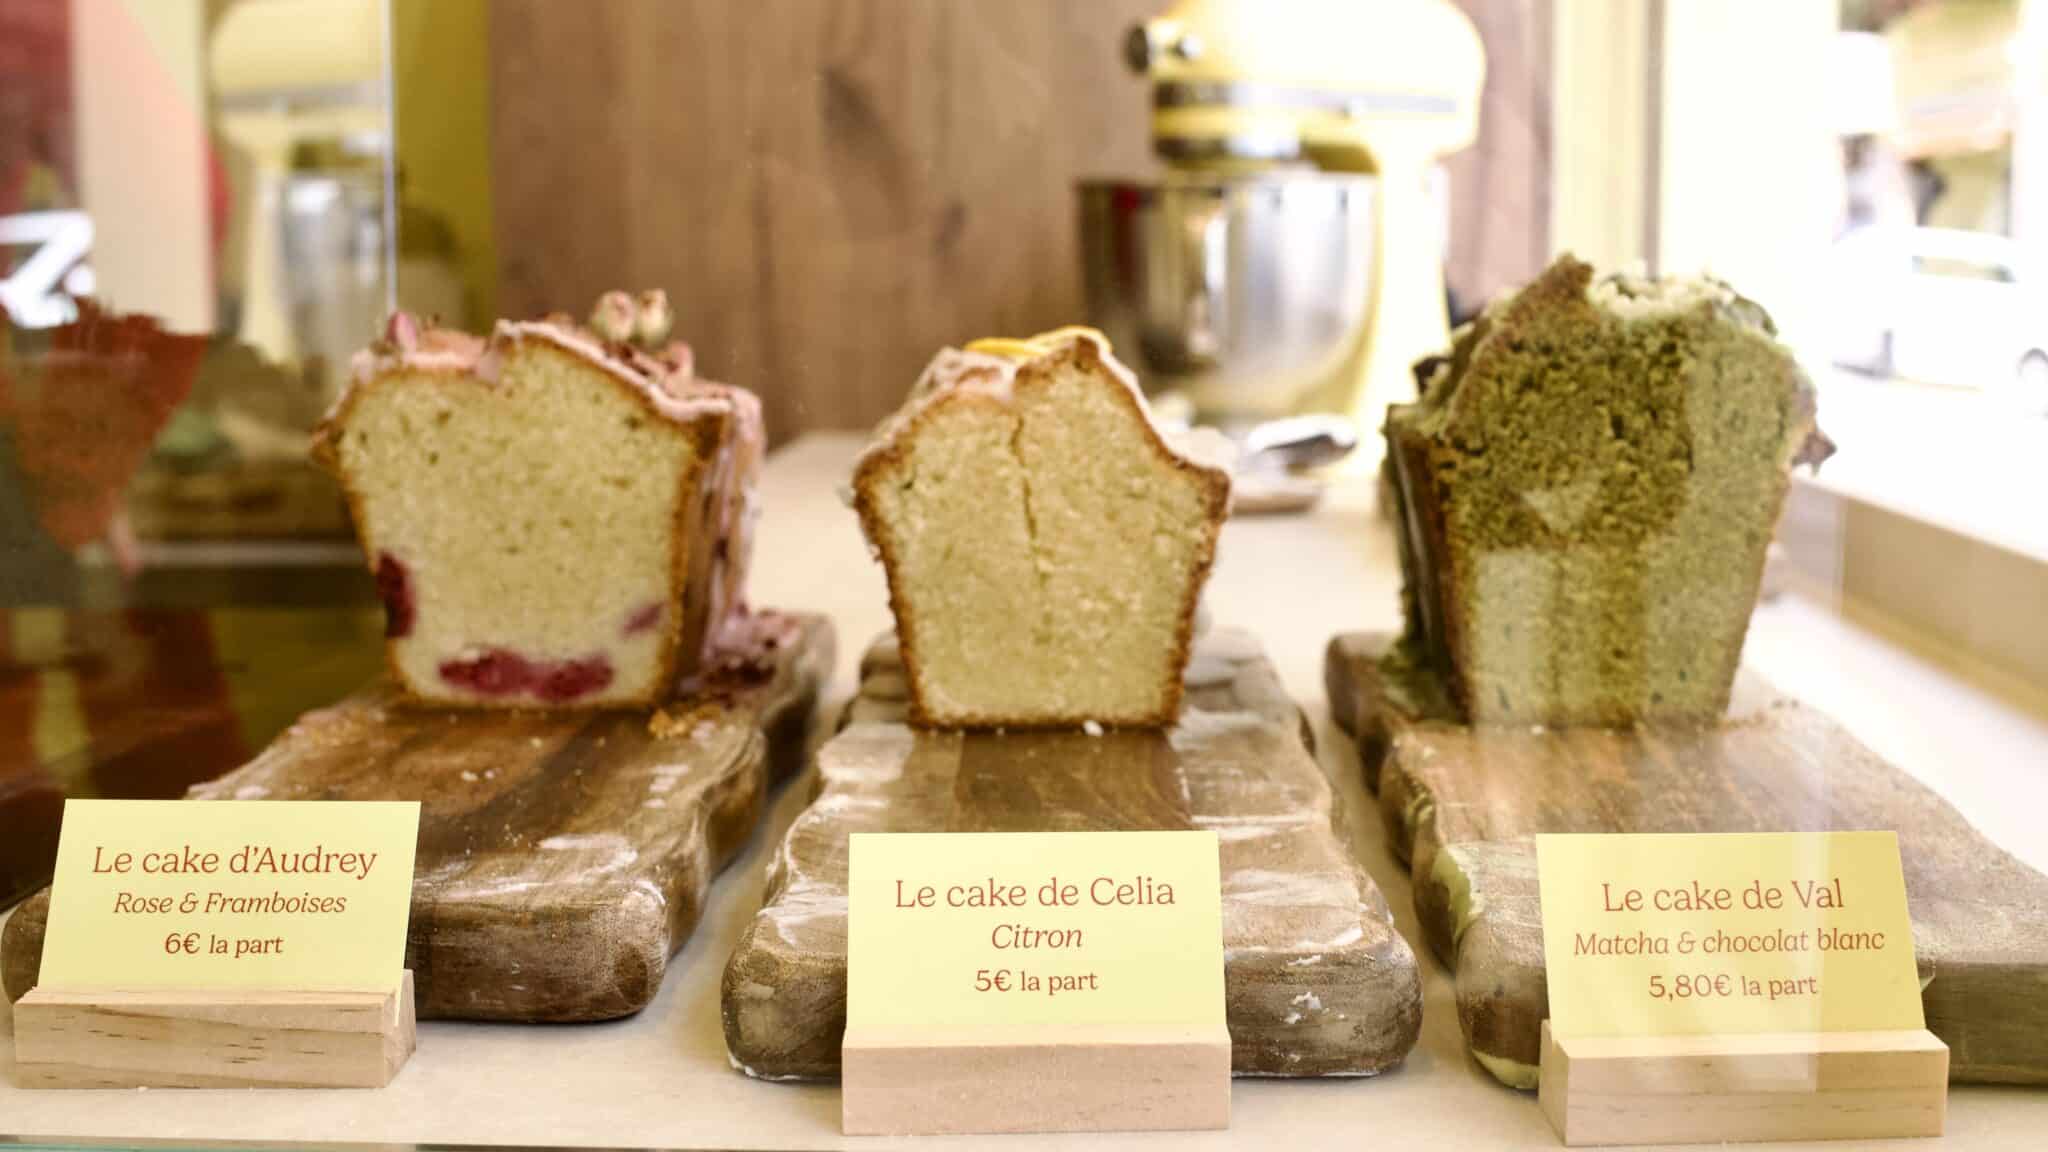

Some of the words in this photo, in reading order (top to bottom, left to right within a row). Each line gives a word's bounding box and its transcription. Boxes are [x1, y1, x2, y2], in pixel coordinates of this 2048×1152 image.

[91, 845, 133, 875] Le
[142, 844, 220, 875] cake
[112, 891, 174, 915] Rose
[178, 891, 200, 915] &
[203, 890, 348, 914] Framboises
[895, 879, 937, 909] Le
[946, 876, 1027, 908] cake
[1037, 876, 1080, 907] de
[1089, 875, 1176, 907] Celia
[1601, 882, 1644, 913] Le
[1653, 879, 1733, 912] cake
[1742, 879, 1784, 910] de
[1790, 877, 1845, 909] Val
[163, 932, 201, 955] 6€
[207, 933, 229, 955] la
[233, 936, 285, 960] part
[991, 923, 1083, 950] Citron
[1573, 930, 1670, 957] Matcha
[1676, 931, 1697, 955] &
[1702, 927, 1809, 954] chocolat
[1817, 927, 1885, 952] blanc
[973, 968, 1013, 993] 5€
[1020, 969, 1041, 992] la
[1047, 971, 1099, 997] part
[1648, 973, 1733, 1002] 5,80€
[1741, 975, 1763, 997] la
[1767, 976, 1818, 1001] part
